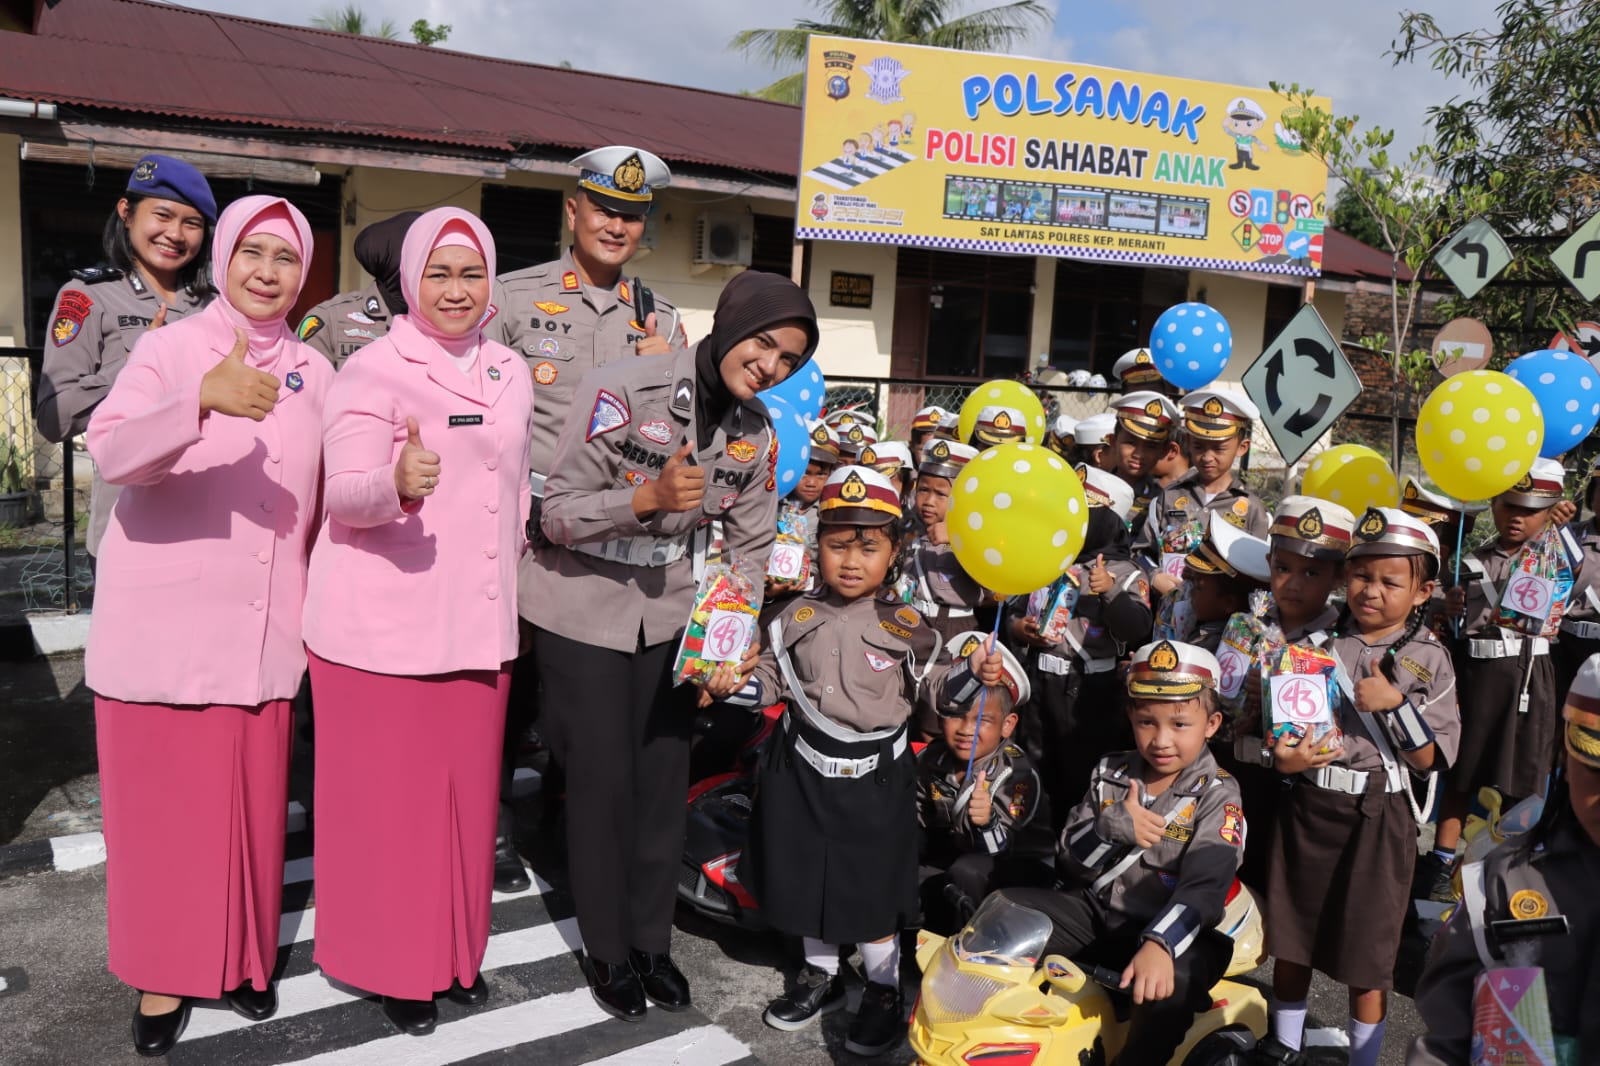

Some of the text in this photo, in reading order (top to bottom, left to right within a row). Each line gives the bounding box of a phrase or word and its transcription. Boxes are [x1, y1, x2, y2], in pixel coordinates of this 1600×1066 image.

[963, 73, 1205, 142] POLSANAK
[926, 130, 1226, 187] POLISI SAHABAT ANAK
[980, 227, 1166, 250] SAT LANTAS POLRES KEP. MERANTI
[530, 317, 573, 334] BOY
[774, 549, 793, 575] 43
[1514, 580, 1540, 611] 43
[713, 617, 738, 656] 43
[1219, 654, 1237, 690] 43
[1282, 679, 1317, 718] 43
